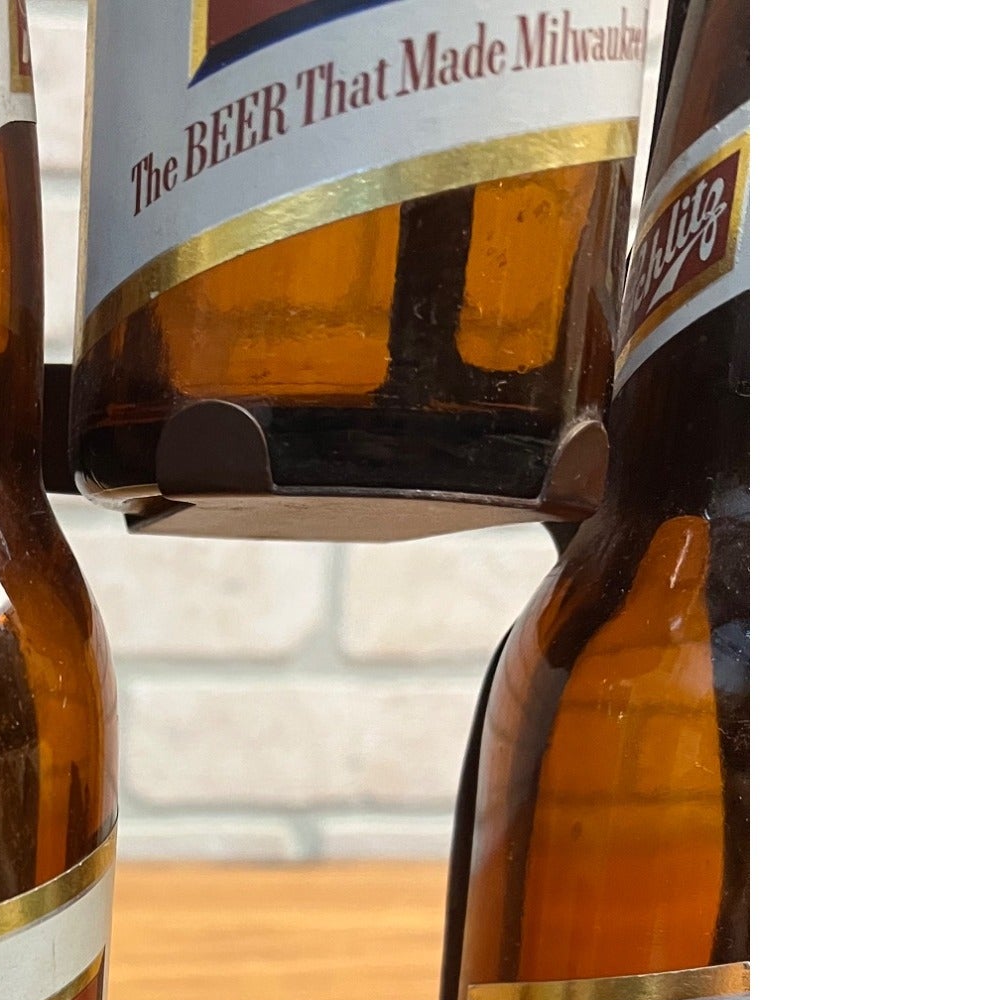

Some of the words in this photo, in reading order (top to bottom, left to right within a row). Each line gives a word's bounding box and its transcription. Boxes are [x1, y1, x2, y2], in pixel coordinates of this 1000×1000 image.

[131, 151, 178, 217] The
[184, 81, 289, 182] BEER
[296, 58, 391, 128] That
[395, 21, 506, 97] Made
